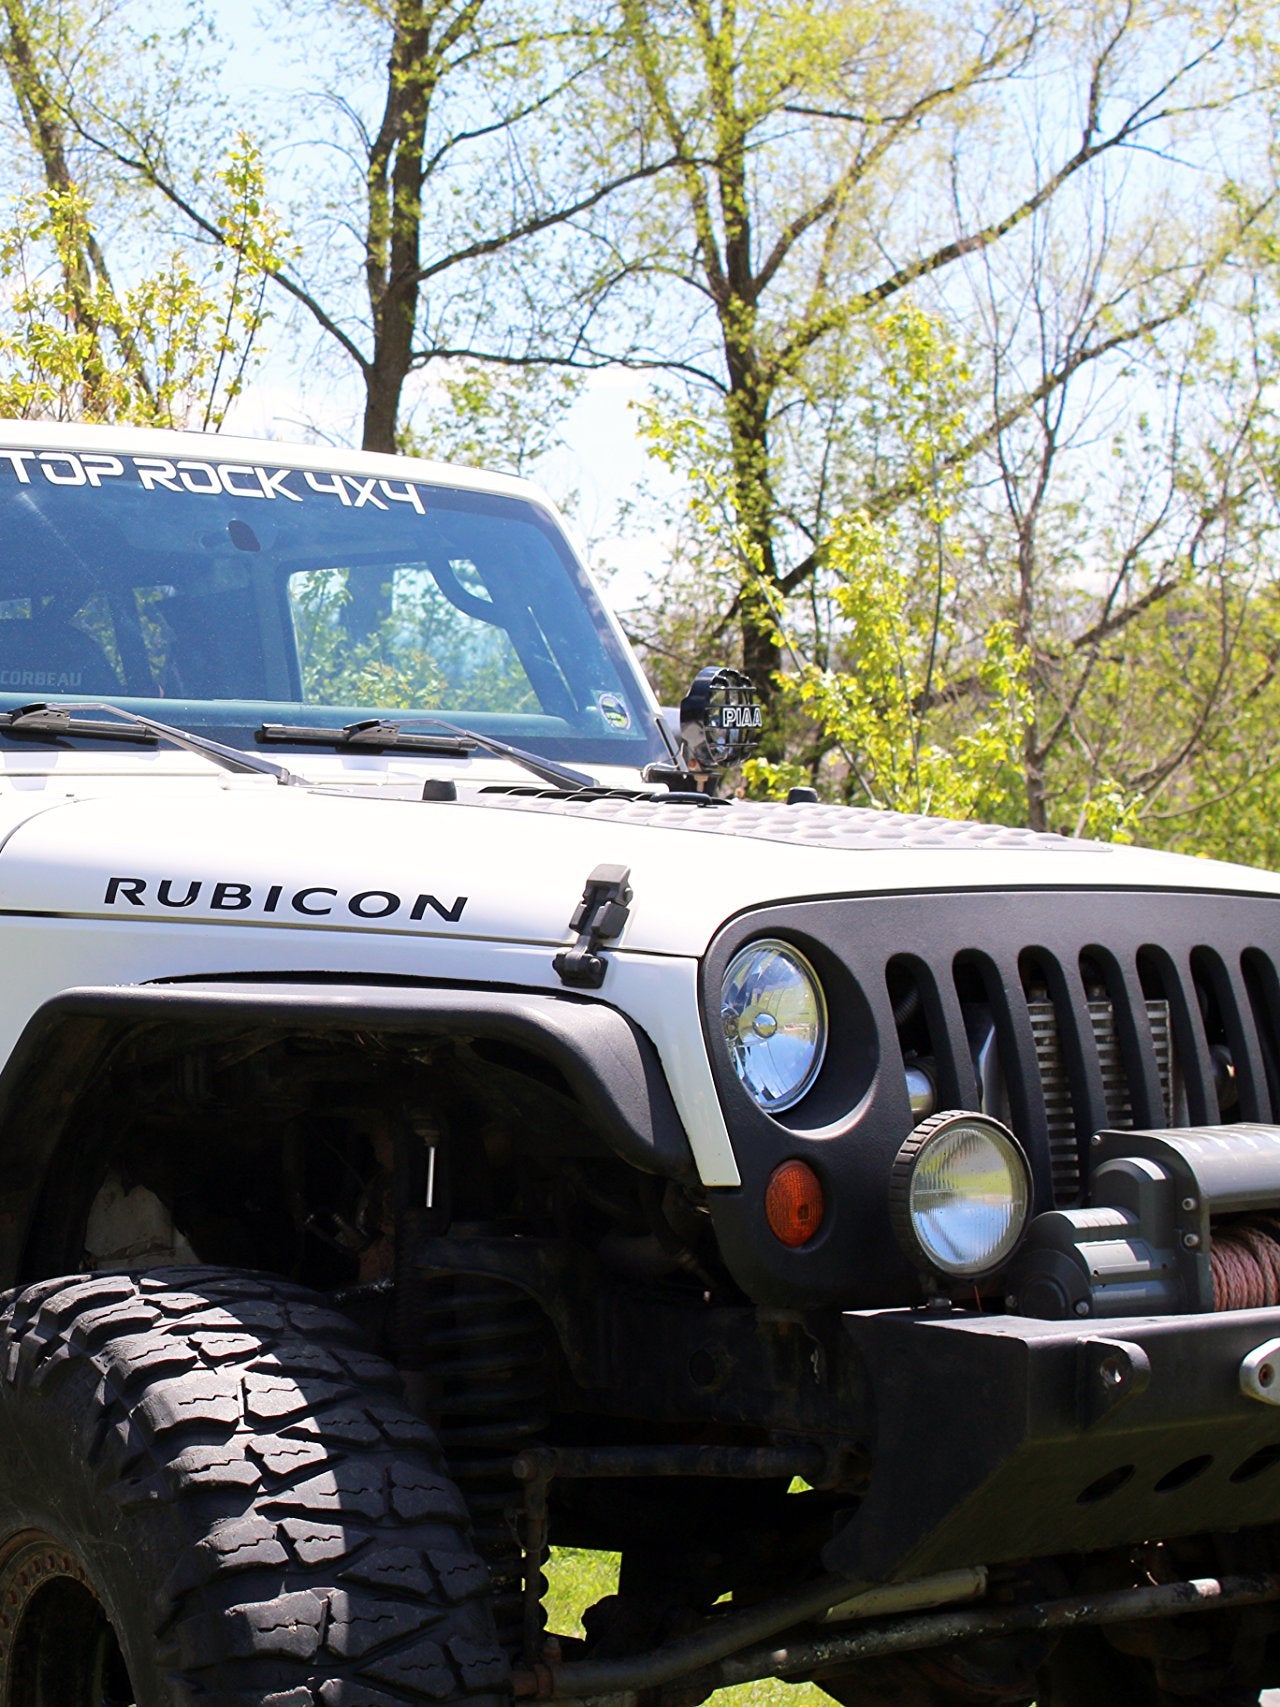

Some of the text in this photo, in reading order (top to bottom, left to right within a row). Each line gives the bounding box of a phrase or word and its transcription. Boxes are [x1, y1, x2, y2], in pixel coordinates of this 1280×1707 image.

[132, 457, 304, 502] ROCK
[0, 670, 82, 687] CORBEAU
[722, 707, 763, 728] PIAA
[104, 877, 469, 923] RUBICON
